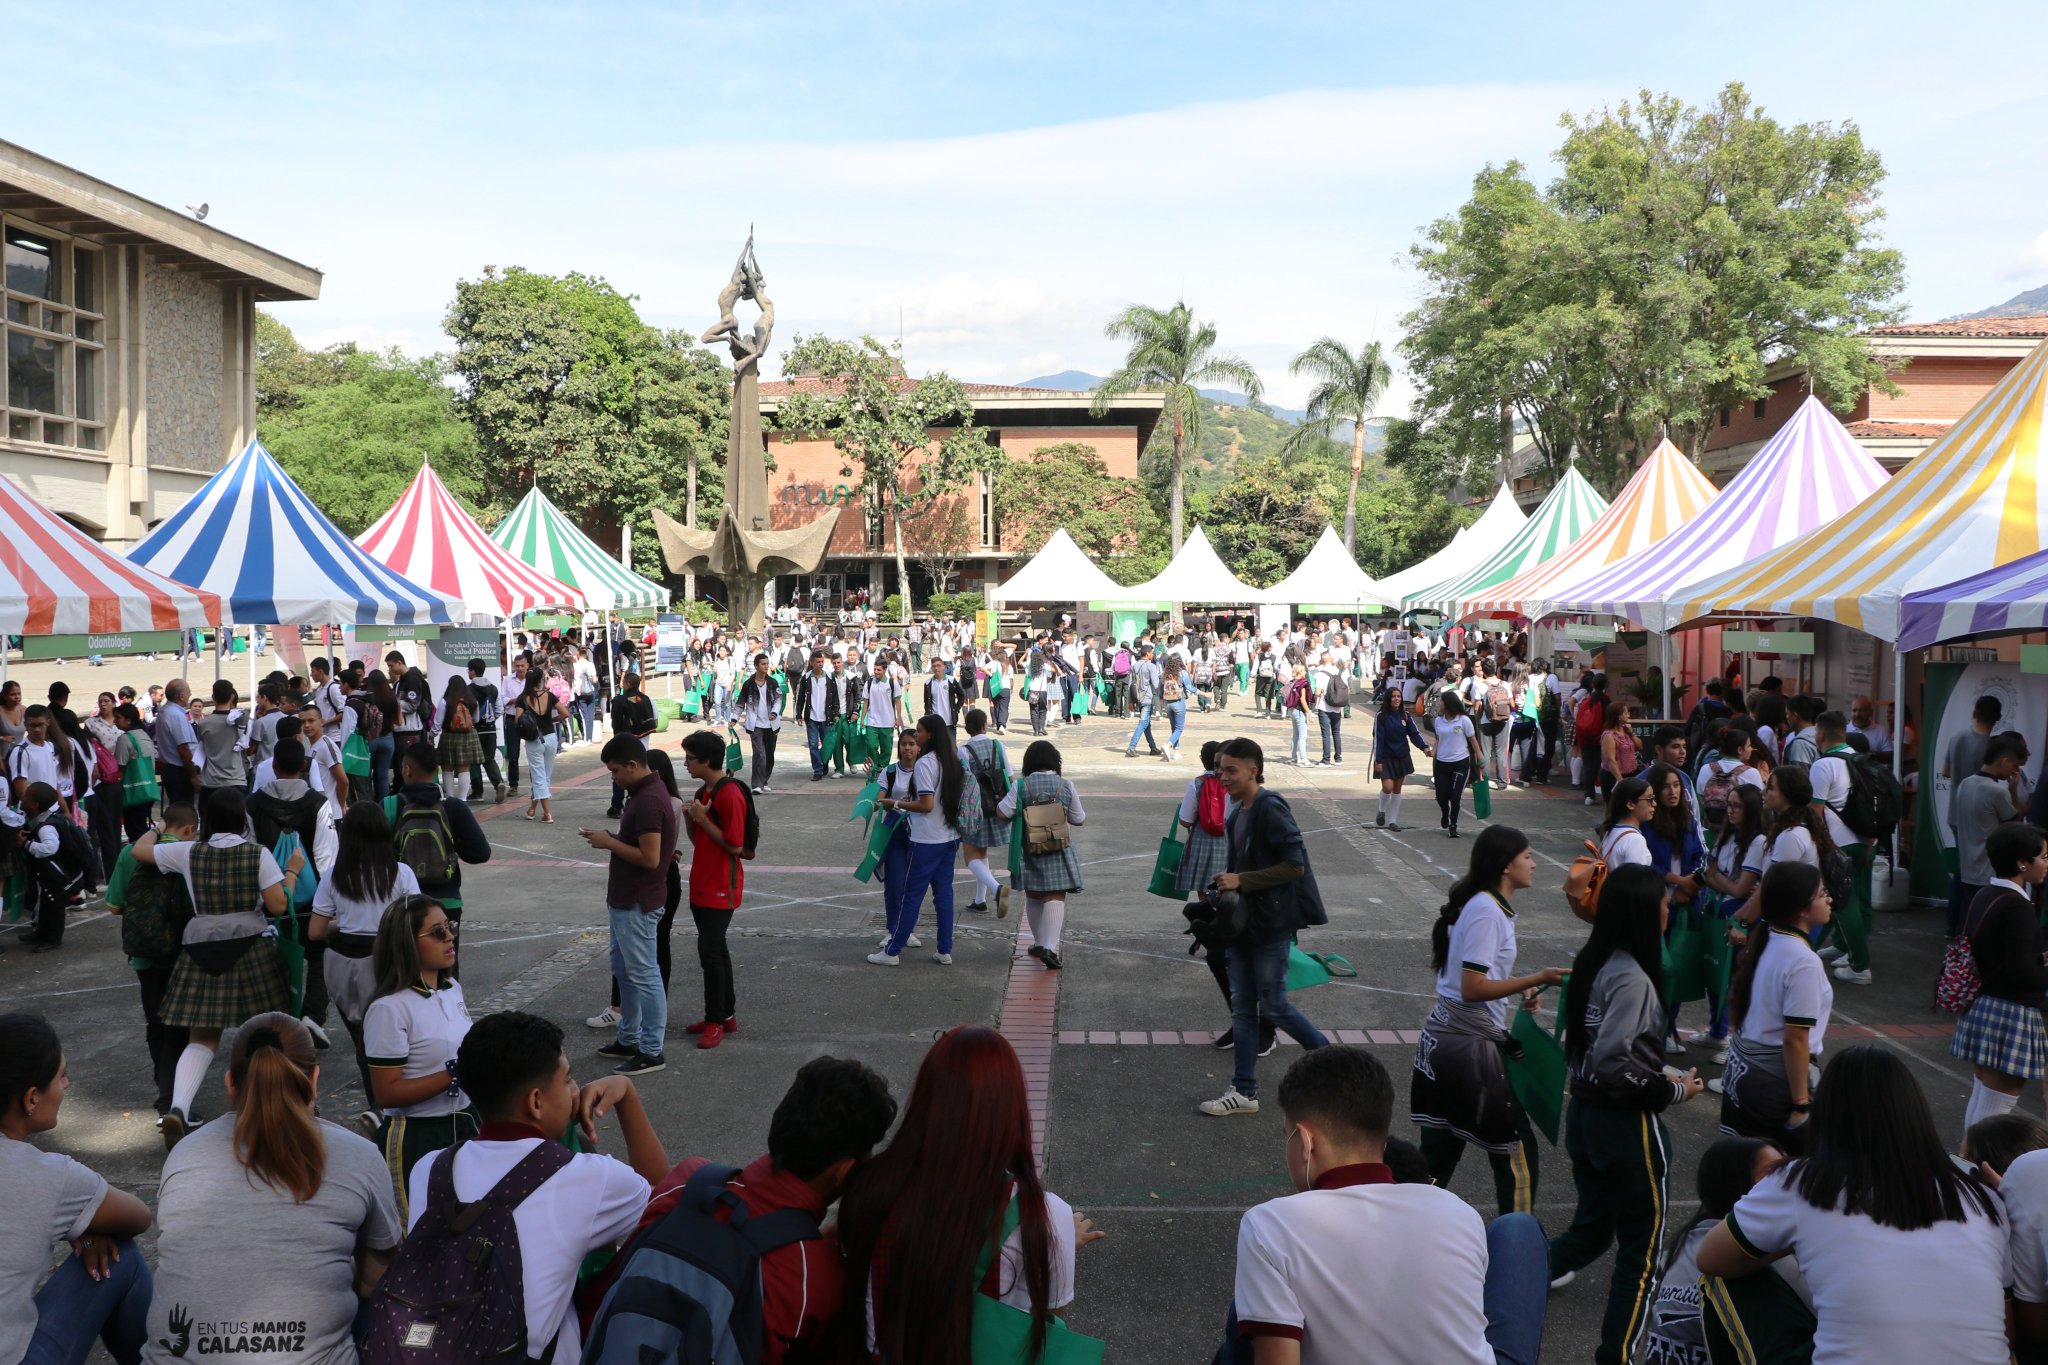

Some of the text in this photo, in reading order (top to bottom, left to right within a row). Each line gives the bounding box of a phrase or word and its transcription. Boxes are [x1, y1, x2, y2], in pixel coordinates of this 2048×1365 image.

[88, 634, 132, 650] Odontología
[444, 641, 470, 649] Facultad
[473, 647, 497, 655] Pública
[197, 1321, 307, 1335] EN TUS MANOS
[197, 1335, 306, 1355] CALASANZ
